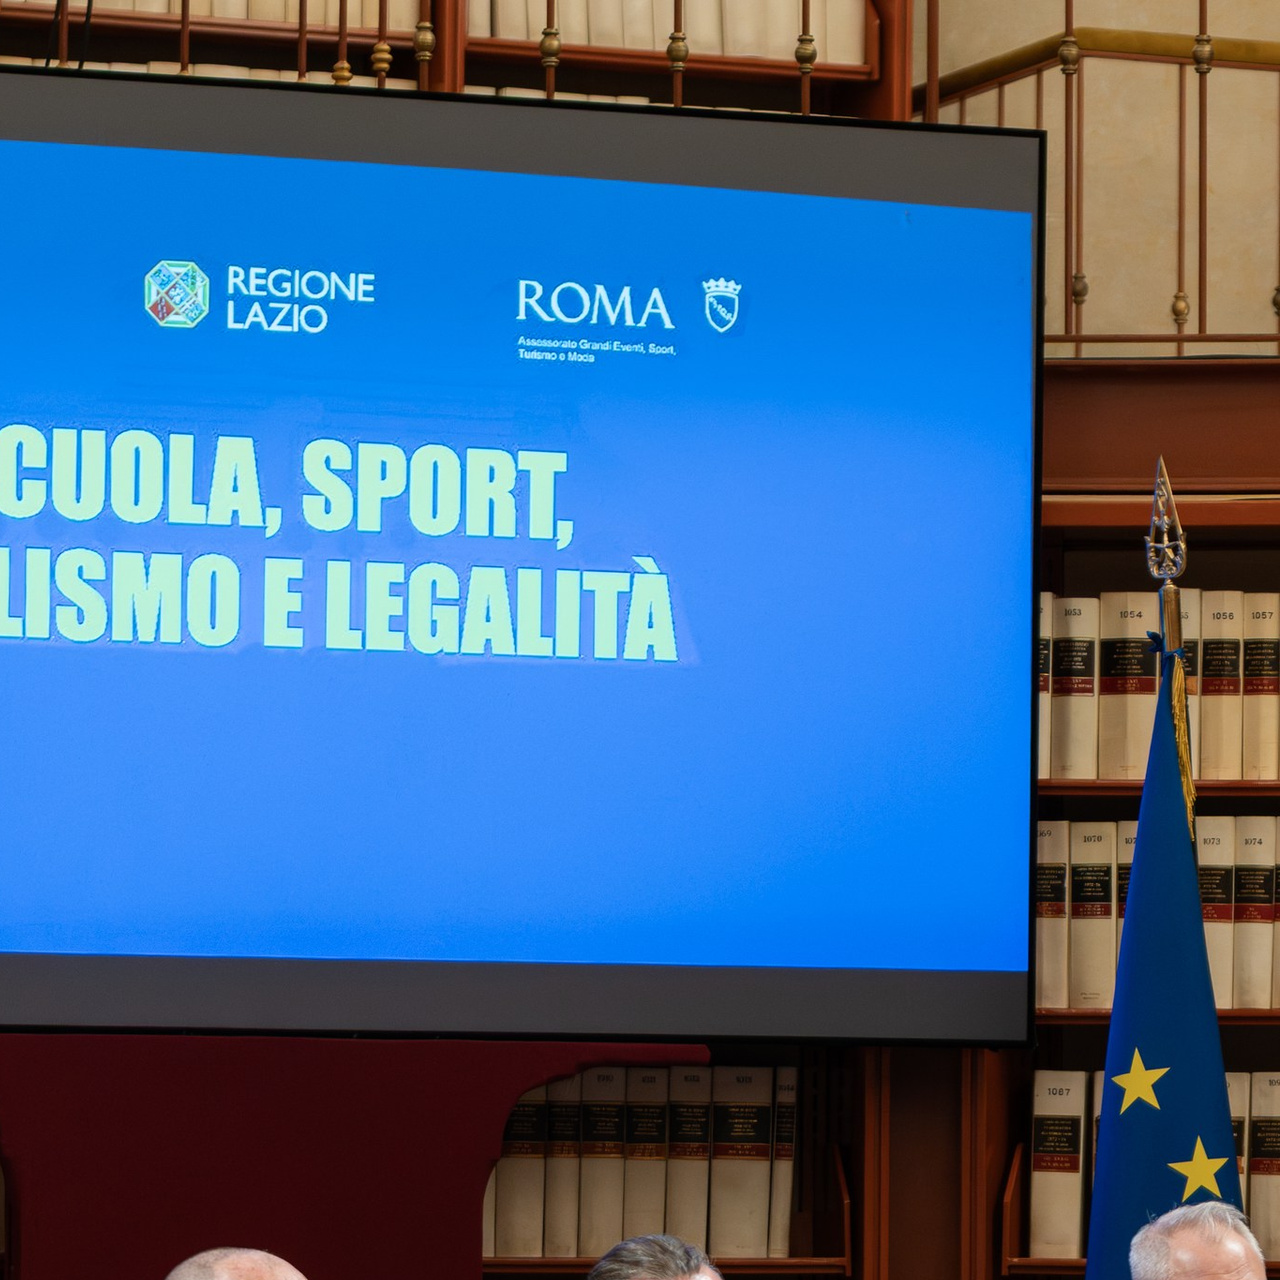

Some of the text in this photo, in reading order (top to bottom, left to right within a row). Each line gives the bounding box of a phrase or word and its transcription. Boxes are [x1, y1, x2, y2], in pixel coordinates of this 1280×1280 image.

[228, 265, 375, 302] REGIONE
[517, 279, 675, 330] ROMA
[227, 301, 328, 334] LAZIO
[518, 336, 677, 355] Assessorato Grandi Eventi, Sport,
[518, 348, 556, 361] Turismo
[568, 352, 595, 362] Moda
[0, 424, 573, 549] CUOLA, SPORT,
[264, 558, 305, 648] E
[325, 555, 678, 661] LEGALITÀ
[1065, 609, 1082, 617] 1053
[1120, 611, 1143, 619] 1054
[1213, 612, 1235, 621] 1056
[1252, 612, 1274, 620] 1057
[1084, 835, 1103, 843] 1070
[1203, 838, 1221, 846] 1073
[1245, 838, 1263, 846] 1074
[1048, 1088, 1071, 1096] 1087
